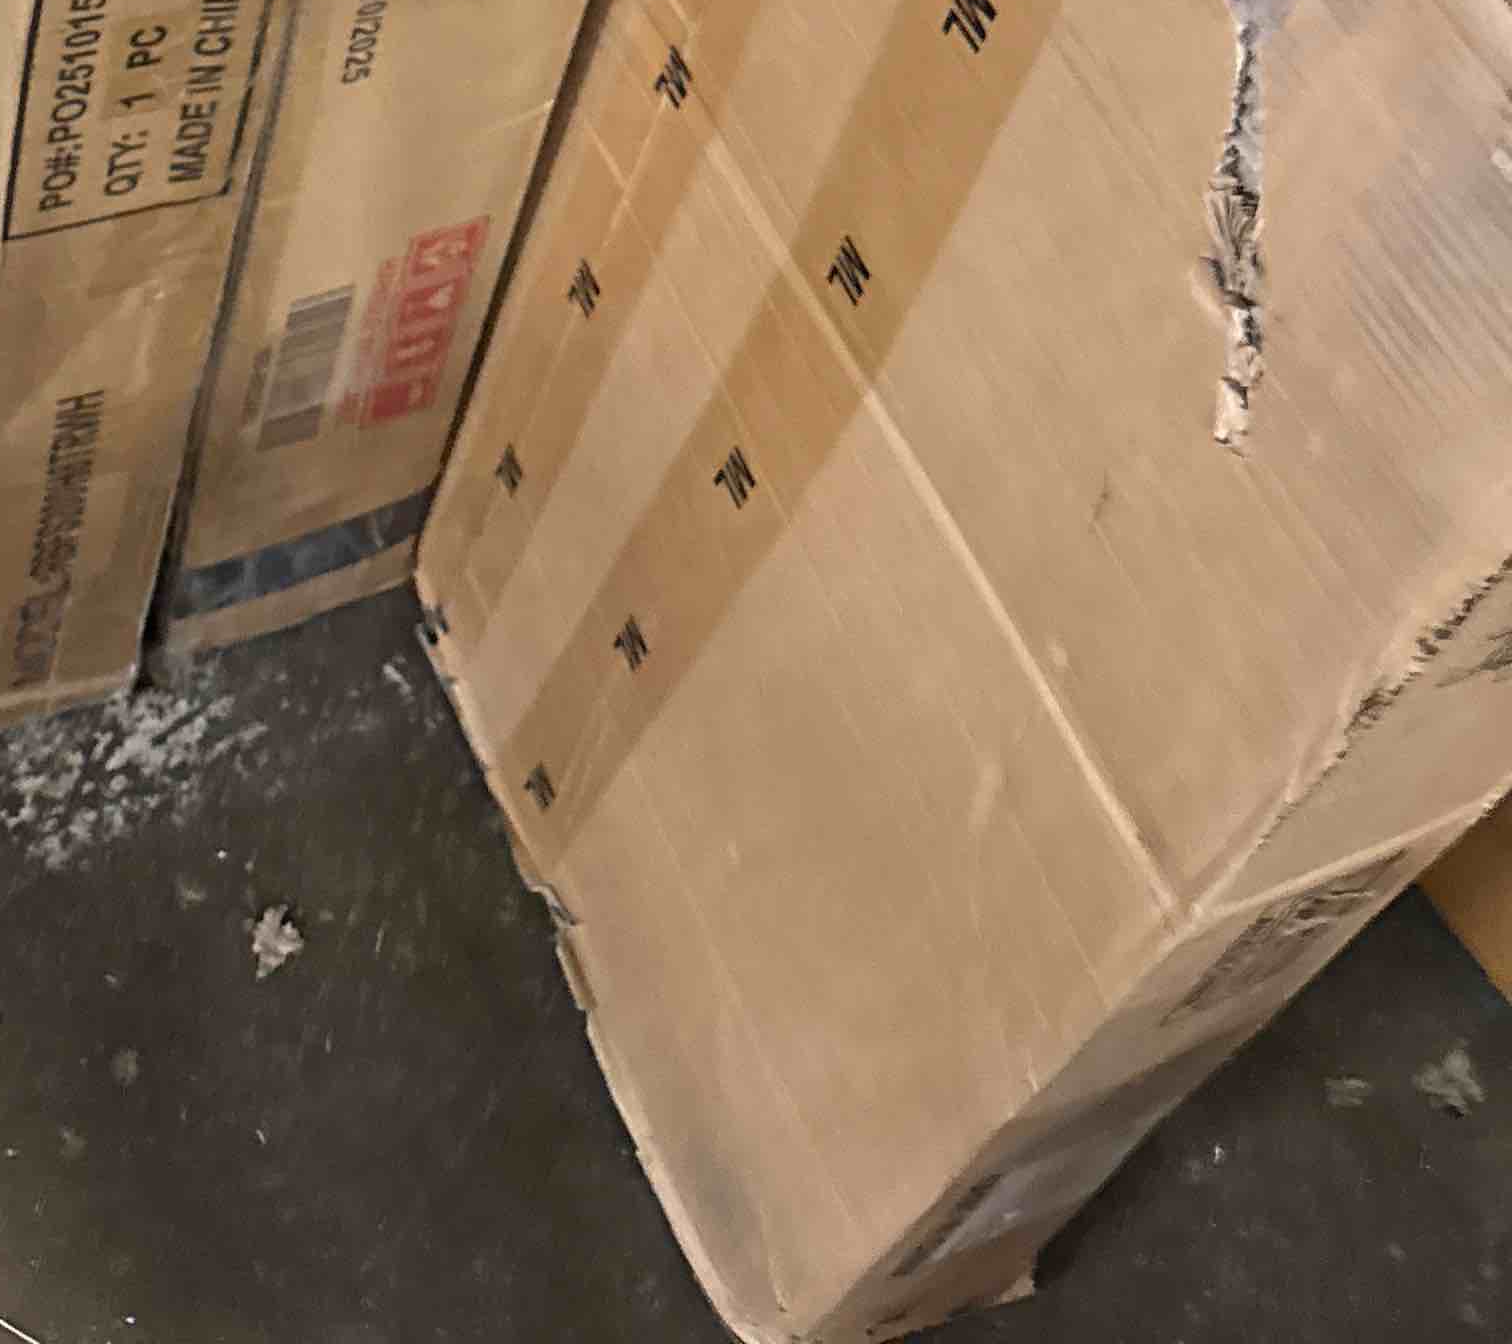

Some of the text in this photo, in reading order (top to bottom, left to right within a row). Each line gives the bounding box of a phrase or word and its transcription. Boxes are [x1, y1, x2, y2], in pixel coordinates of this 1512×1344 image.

[102, 23, 170, 199] QTY: 1 PC
[187, 61, 225, 99] IN
[167, 102, 219, 187] MADE
